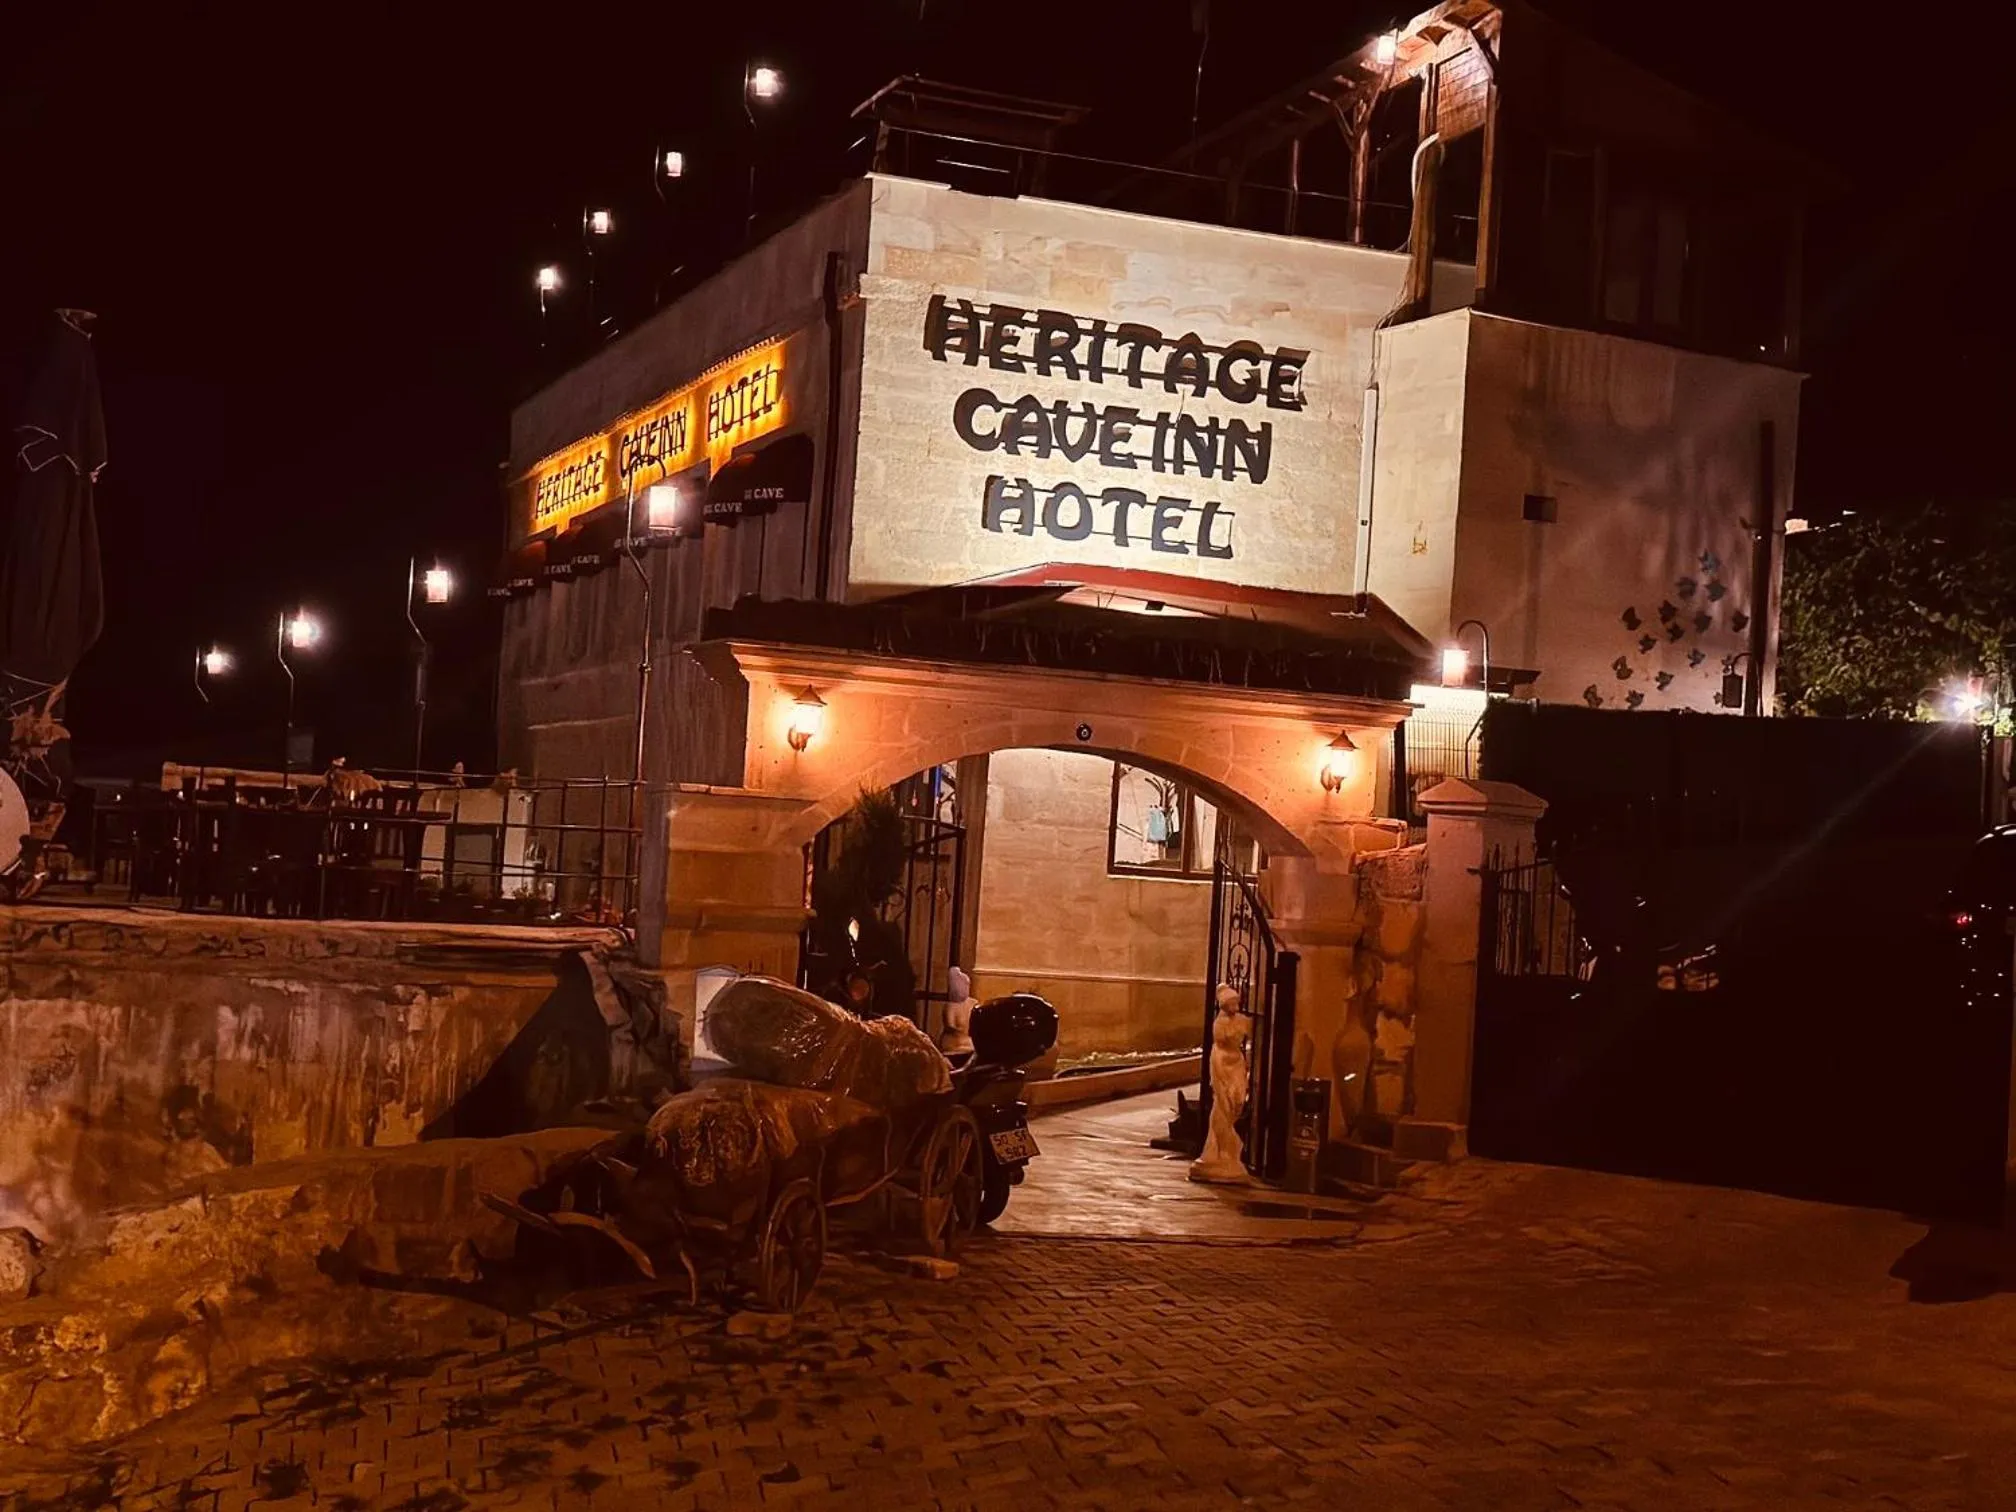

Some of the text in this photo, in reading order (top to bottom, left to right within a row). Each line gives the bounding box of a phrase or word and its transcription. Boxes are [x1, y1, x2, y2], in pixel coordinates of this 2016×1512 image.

[923, 295, 1310, 411] HERITAGE
[708, 364, 773, 442] HOTEL
[714, 502, 743, 513] CAVE
[754, 487, 784, 499] CAVE
[981, 475, 1234, 559] HOTEL
